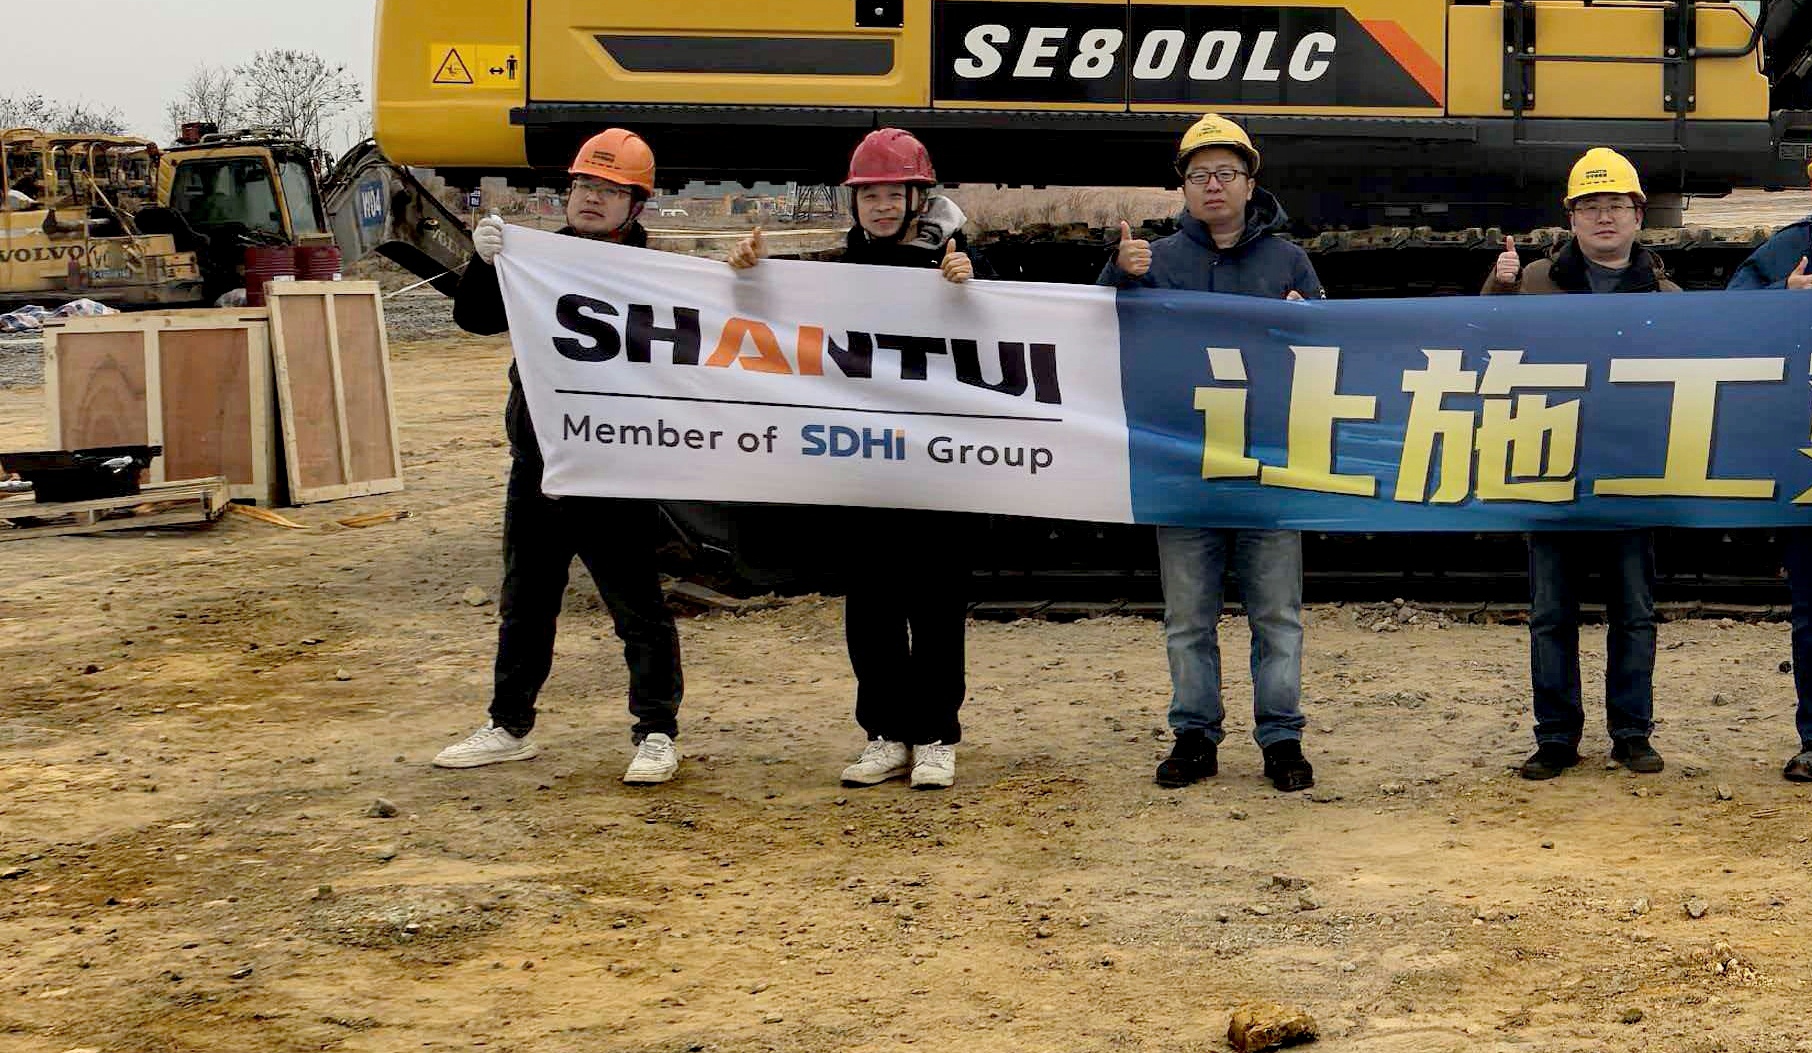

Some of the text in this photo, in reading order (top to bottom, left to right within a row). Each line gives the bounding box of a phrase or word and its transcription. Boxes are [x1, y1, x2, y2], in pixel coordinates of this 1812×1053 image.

[954, 24, 1338, 83] SE800LC
[0, 245, 84, 262] VOLVO
[551, 293, 1063, 405] SHANTUI
[562, 413, 723, 450] Member
[736, 425, 779, 454] of
[927, 436, 1054, 475] Group
